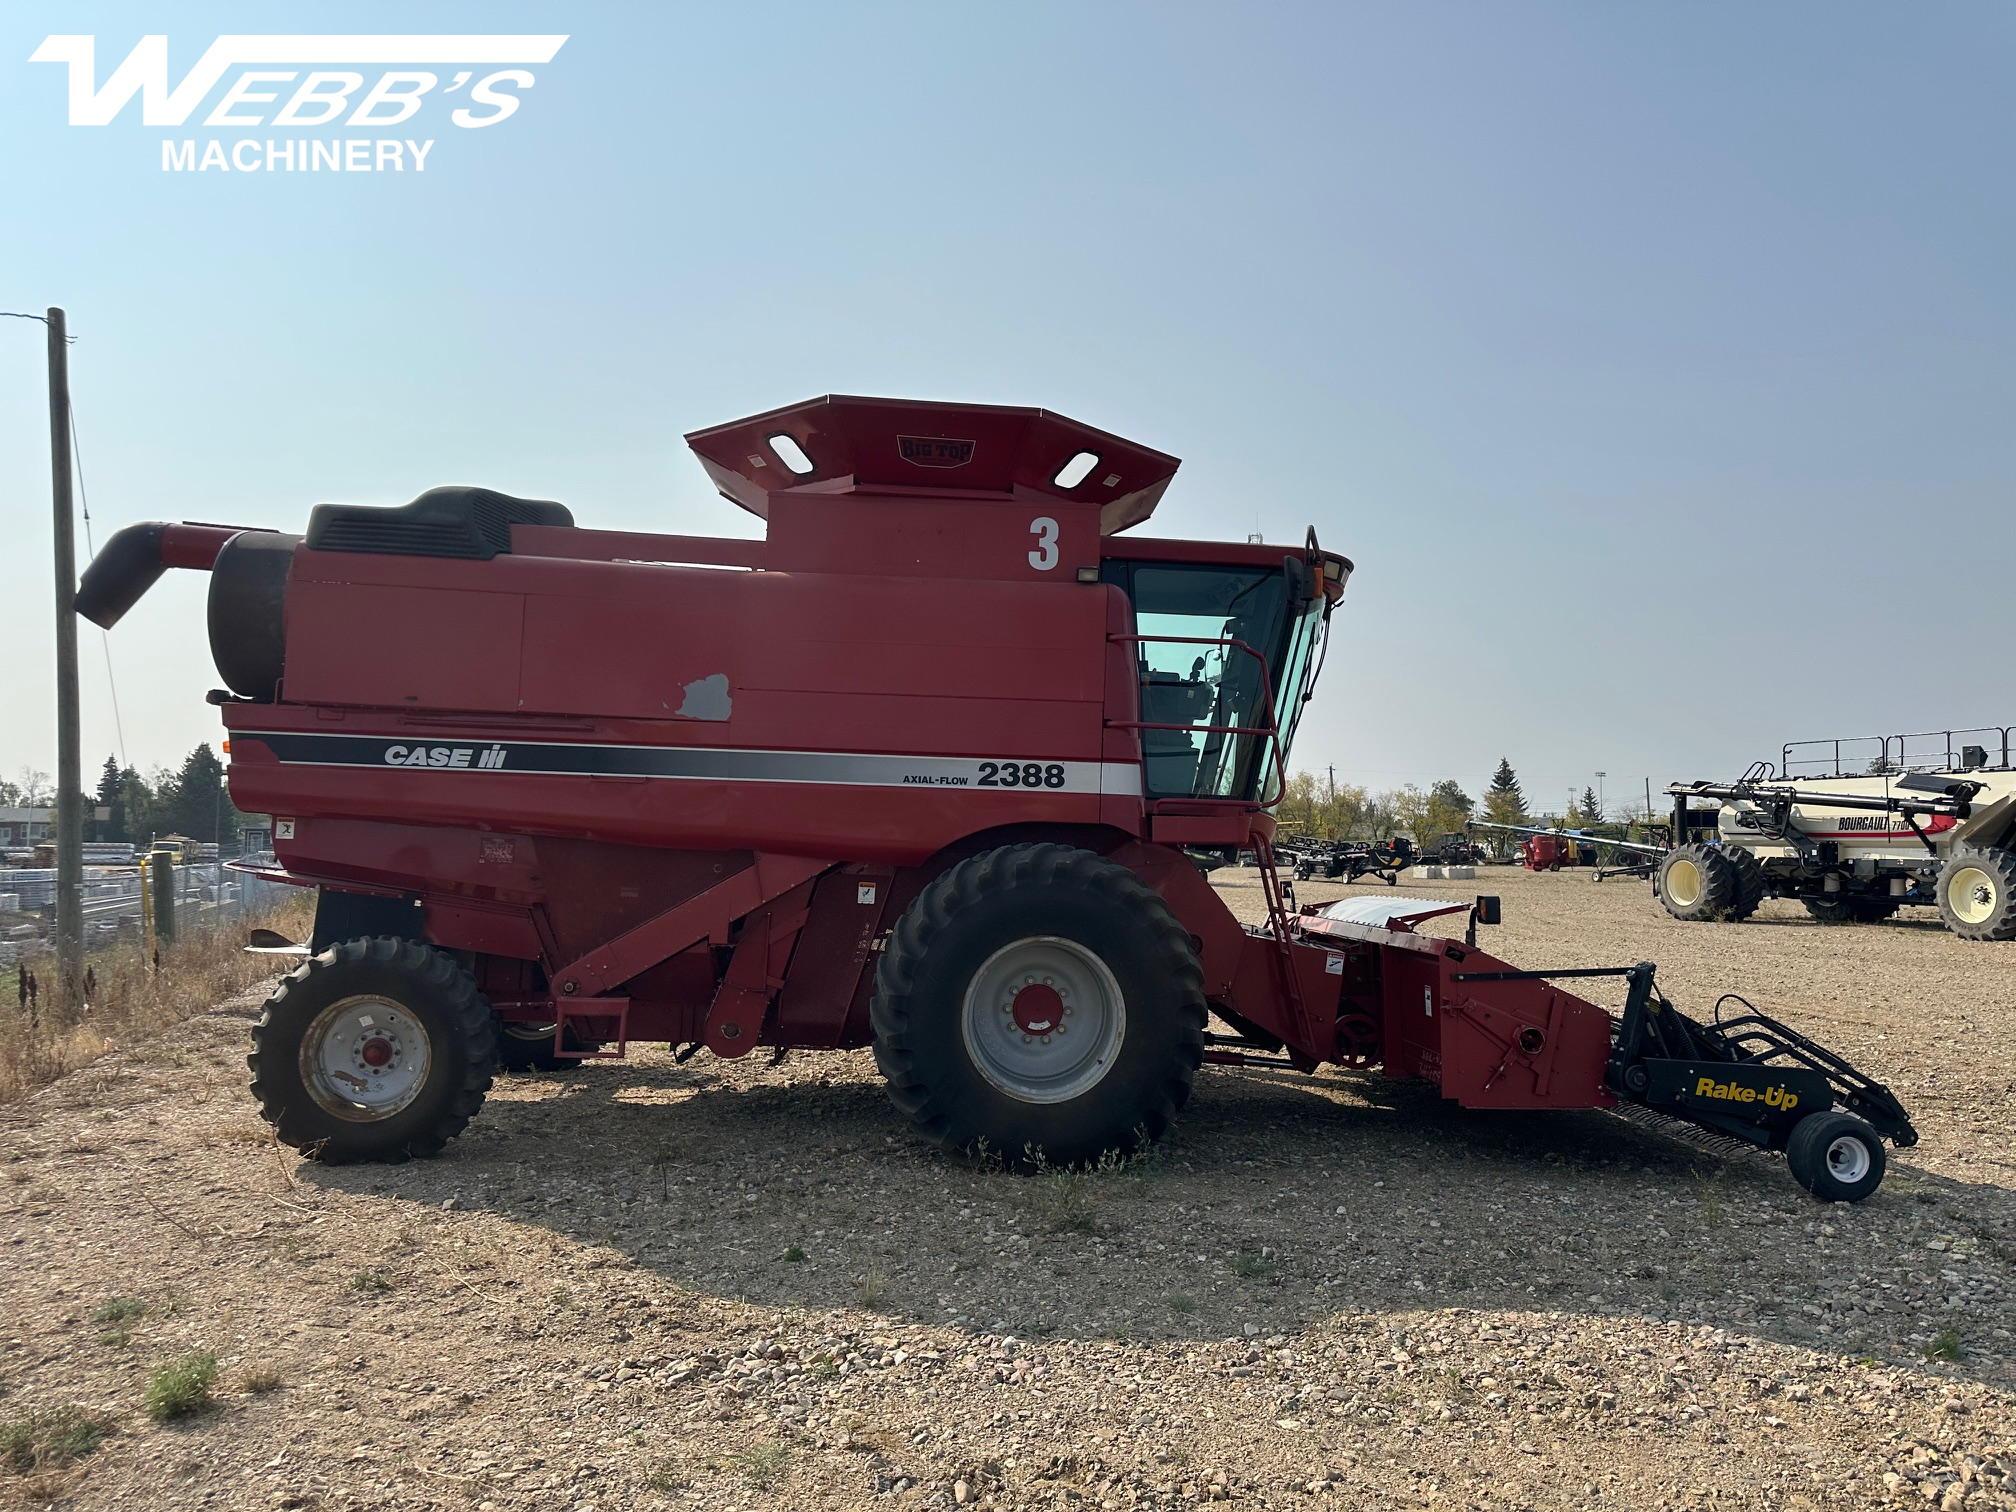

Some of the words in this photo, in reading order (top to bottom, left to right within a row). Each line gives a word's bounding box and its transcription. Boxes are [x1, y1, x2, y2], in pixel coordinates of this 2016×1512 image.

[936, 444, 971, 460] TOP
[1028, 516, 1059, 571] 3
[384, 745, 473, 767] CASE
[903, 775, 968, 785] AXIAL-FLOW
[977, 762, 1065, 788] 2388
[1838, 817, 1889, 831] BOURGAULT
[1695, 1077, 1798, 1111] Rake-Up
